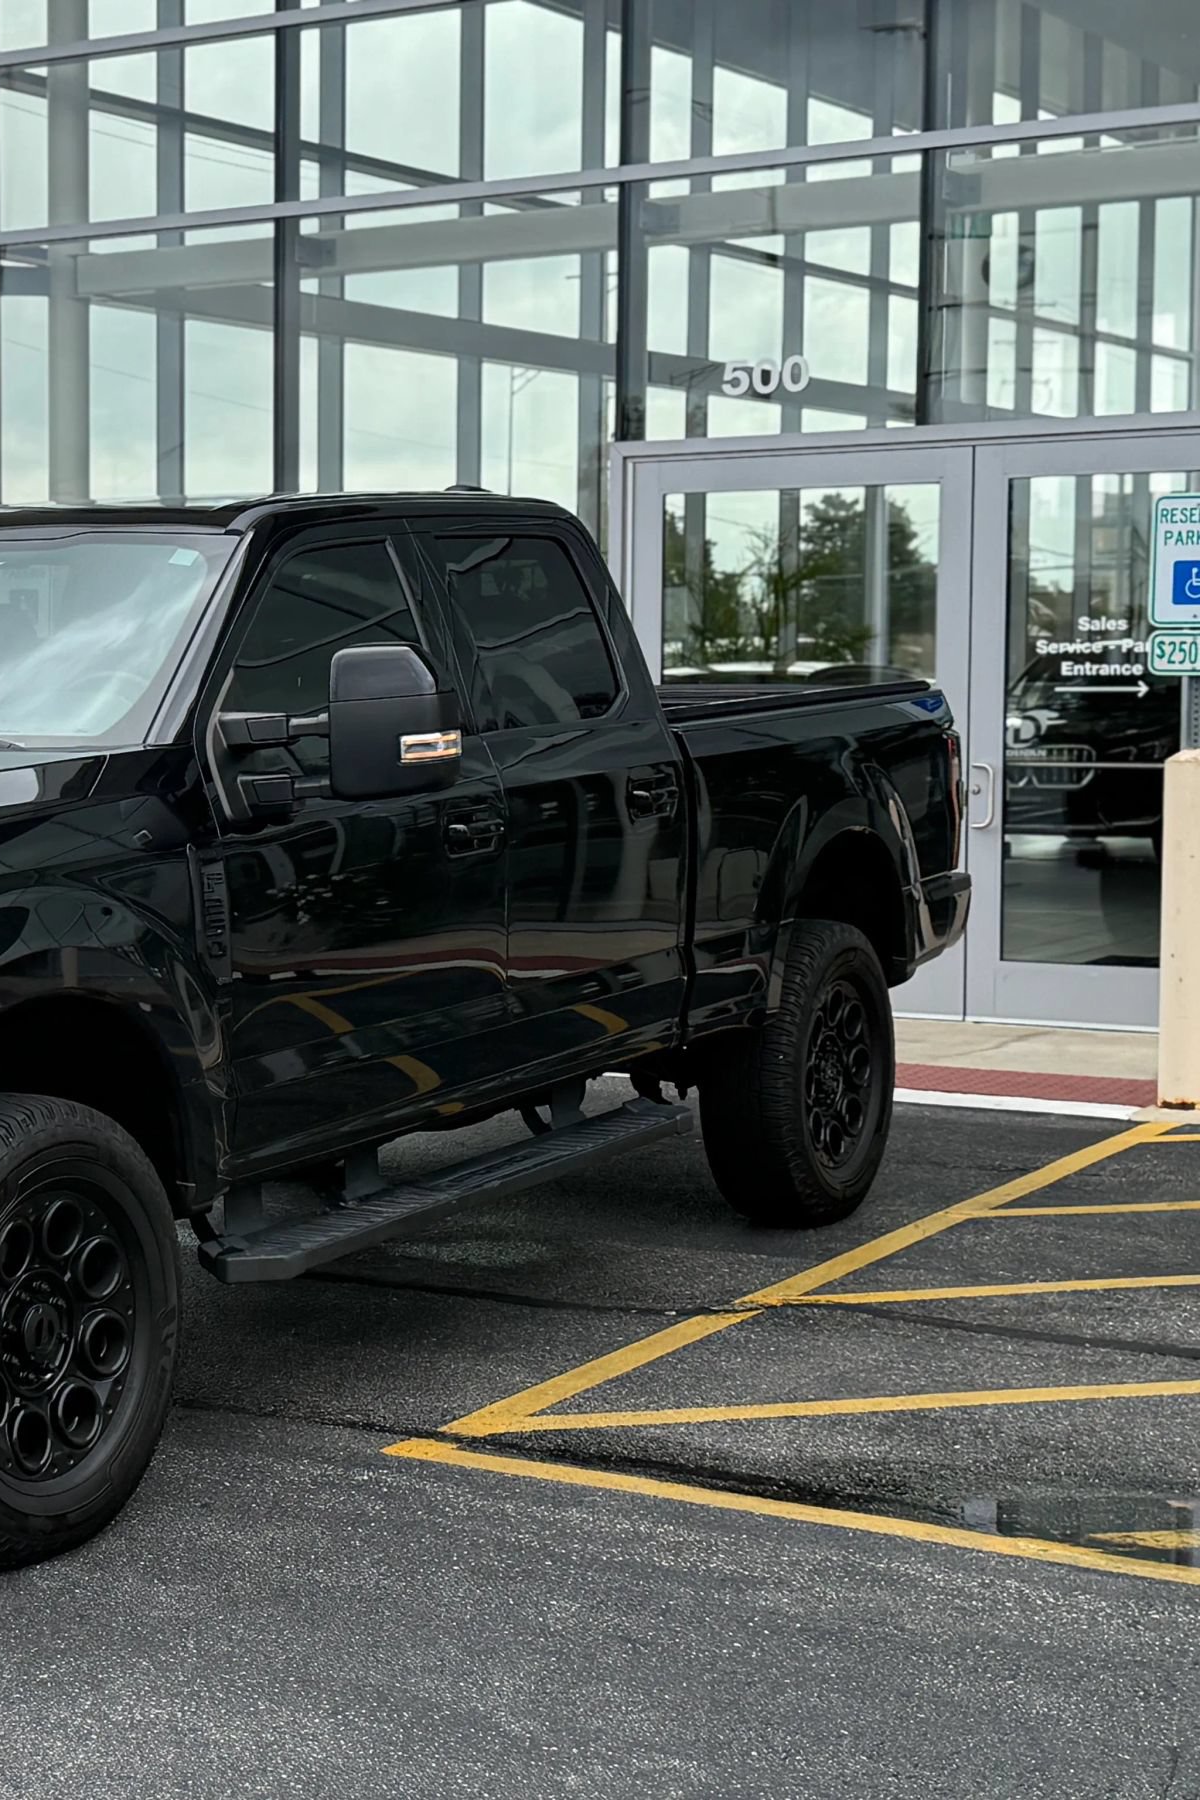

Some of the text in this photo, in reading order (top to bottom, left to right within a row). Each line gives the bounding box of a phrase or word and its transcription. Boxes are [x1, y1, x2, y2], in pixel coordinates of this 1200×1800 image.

[721, 355, 810, 396] 500
[1160, 507, 1200, 524] RESE
[1077, 616, 1129, 631] Sales
[1035, 639, 1103, 654] Service
[1121, 638, 1149, 653] Pa
[1155, 640, 1198, 665] $250
[1060, 661, 1145, 676] Entrance
